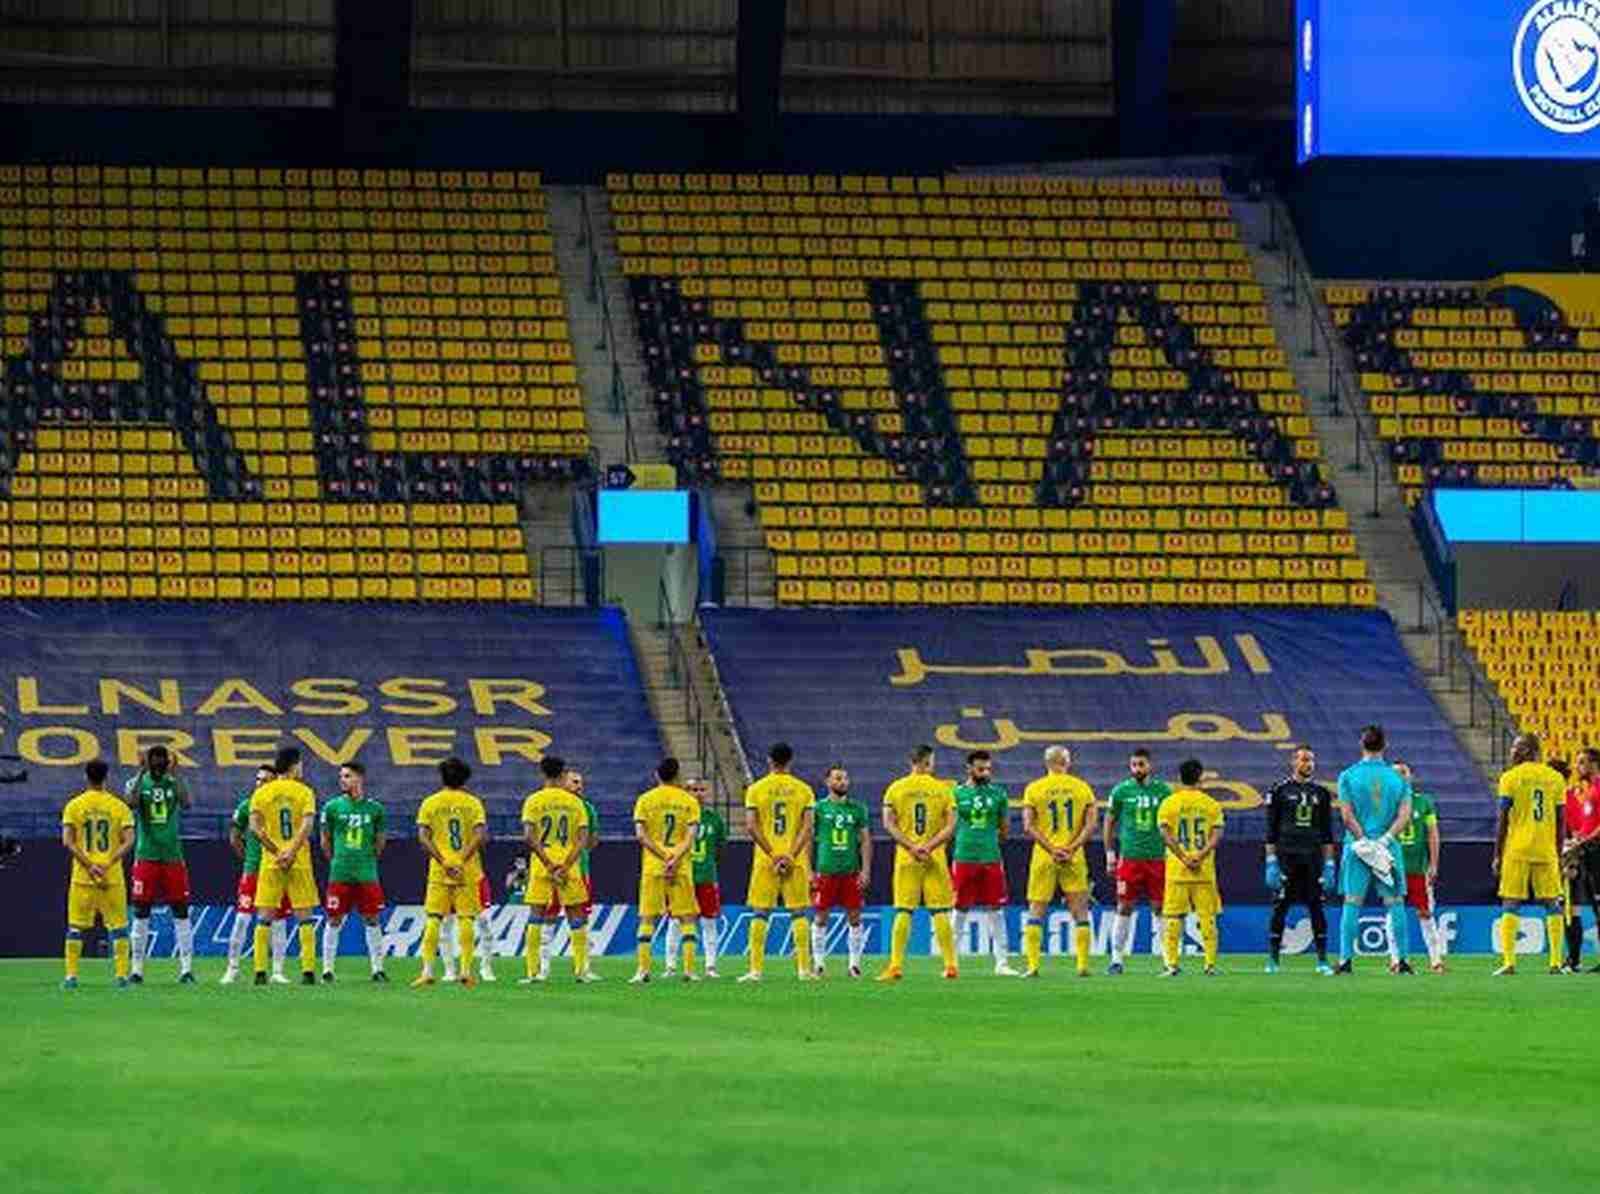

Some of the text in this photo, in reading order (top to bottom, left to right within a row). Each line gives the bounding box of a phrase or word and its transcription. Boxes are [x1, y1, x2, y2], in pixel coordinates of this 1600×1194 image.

[889, 632, 1272, 686] النصر
[0, 676, 552, 715] LNASSR
[0, 725, 553, 766] OREVER
[773, 801, 786, 836] 5
[1047, 798, 1074, 833] 11
[1533, 789, 1544, 822] 3
[84, 818, 110, 853] 13
[449, 818, 462, 851] 8
[540, 814, 570, 848] 24
[664, 813, 676, 847] 2
[1177, 817, 1206, 849] 45
